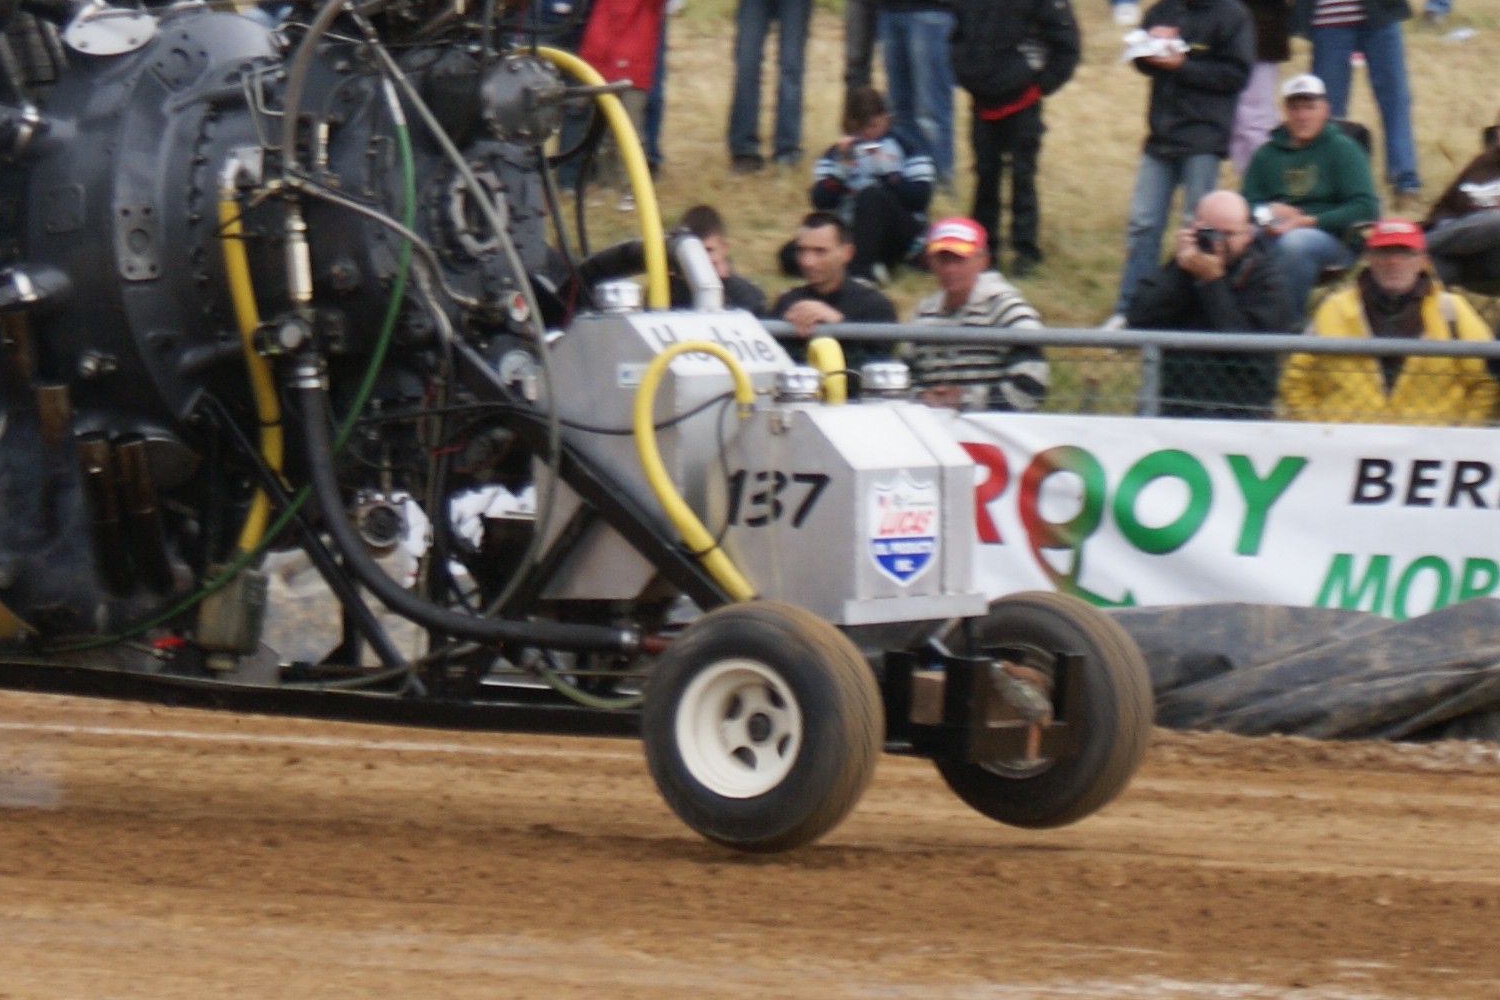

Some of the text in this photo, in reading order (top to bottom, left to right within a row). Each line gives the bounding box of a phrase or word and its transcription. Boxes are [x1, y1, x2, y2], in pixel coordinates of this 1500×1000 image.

[650, 324, 775, 363] Hbie
[728, 469, 831, 529] 137
[1351, 457, 1500, 509] BER
